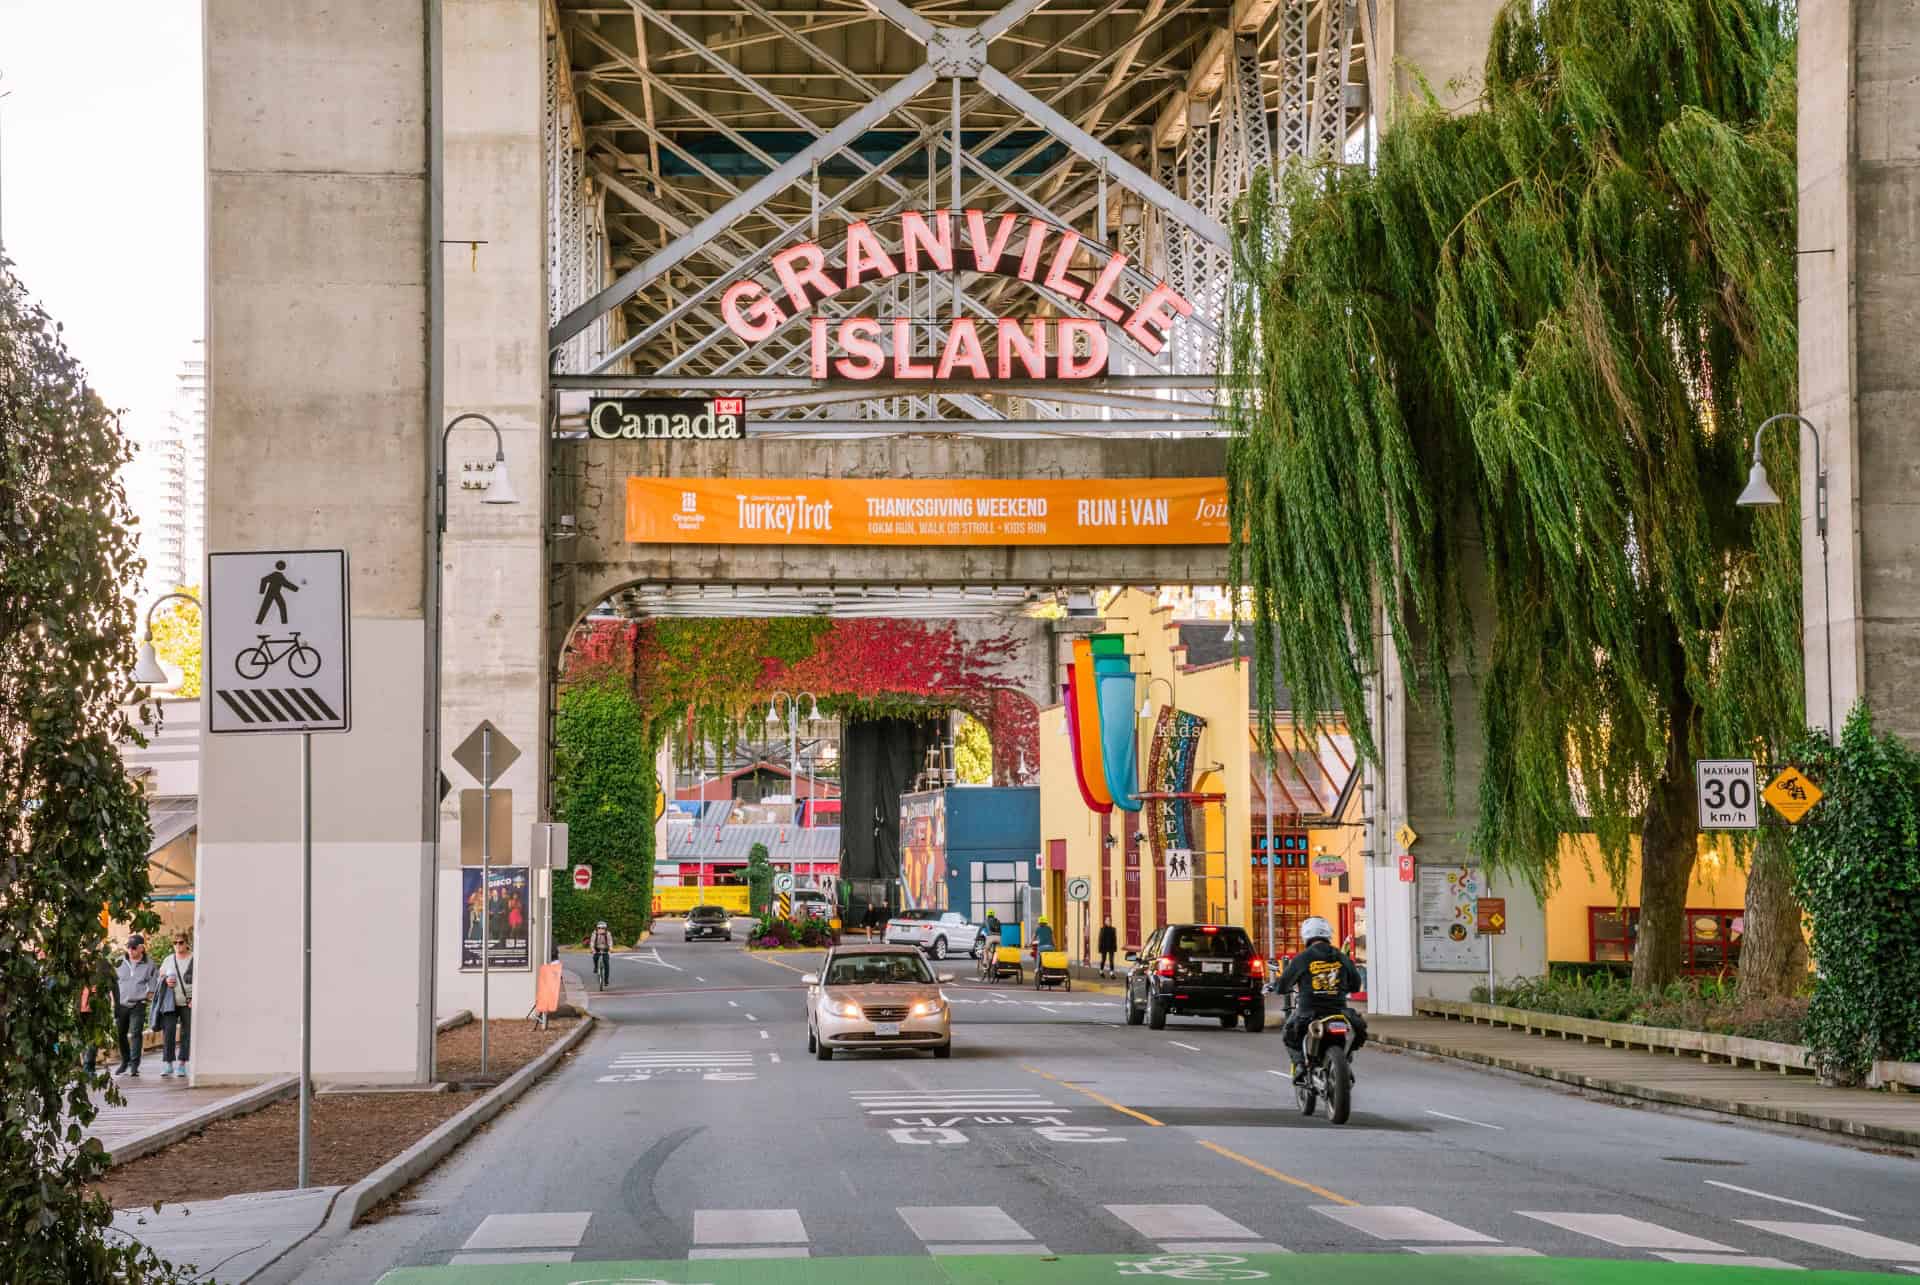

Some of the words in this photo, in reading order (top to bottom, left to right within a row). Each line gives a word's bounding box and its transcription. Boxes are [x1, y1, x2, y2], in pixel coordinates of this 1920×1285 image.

[720, 209, 1193, 355] GRANVILLE
[810, 317, 1110, 380] ISLAND
[590, 401, 741, 439] Canada
[866, 497, 973, 517] THANKSGIVING
[976, 497, 1048, 517] WEEKEND
[1077, 498, 1117, 526] RUN
[1130, 498, 1169, 526] VAN
[1157, 722, 1201, 738] kids
[1703, 767, 1749, 776] MAXIMUM
[1704, 779, 1751, 809] 30
[1710, 812, 1747, 823] km/h
